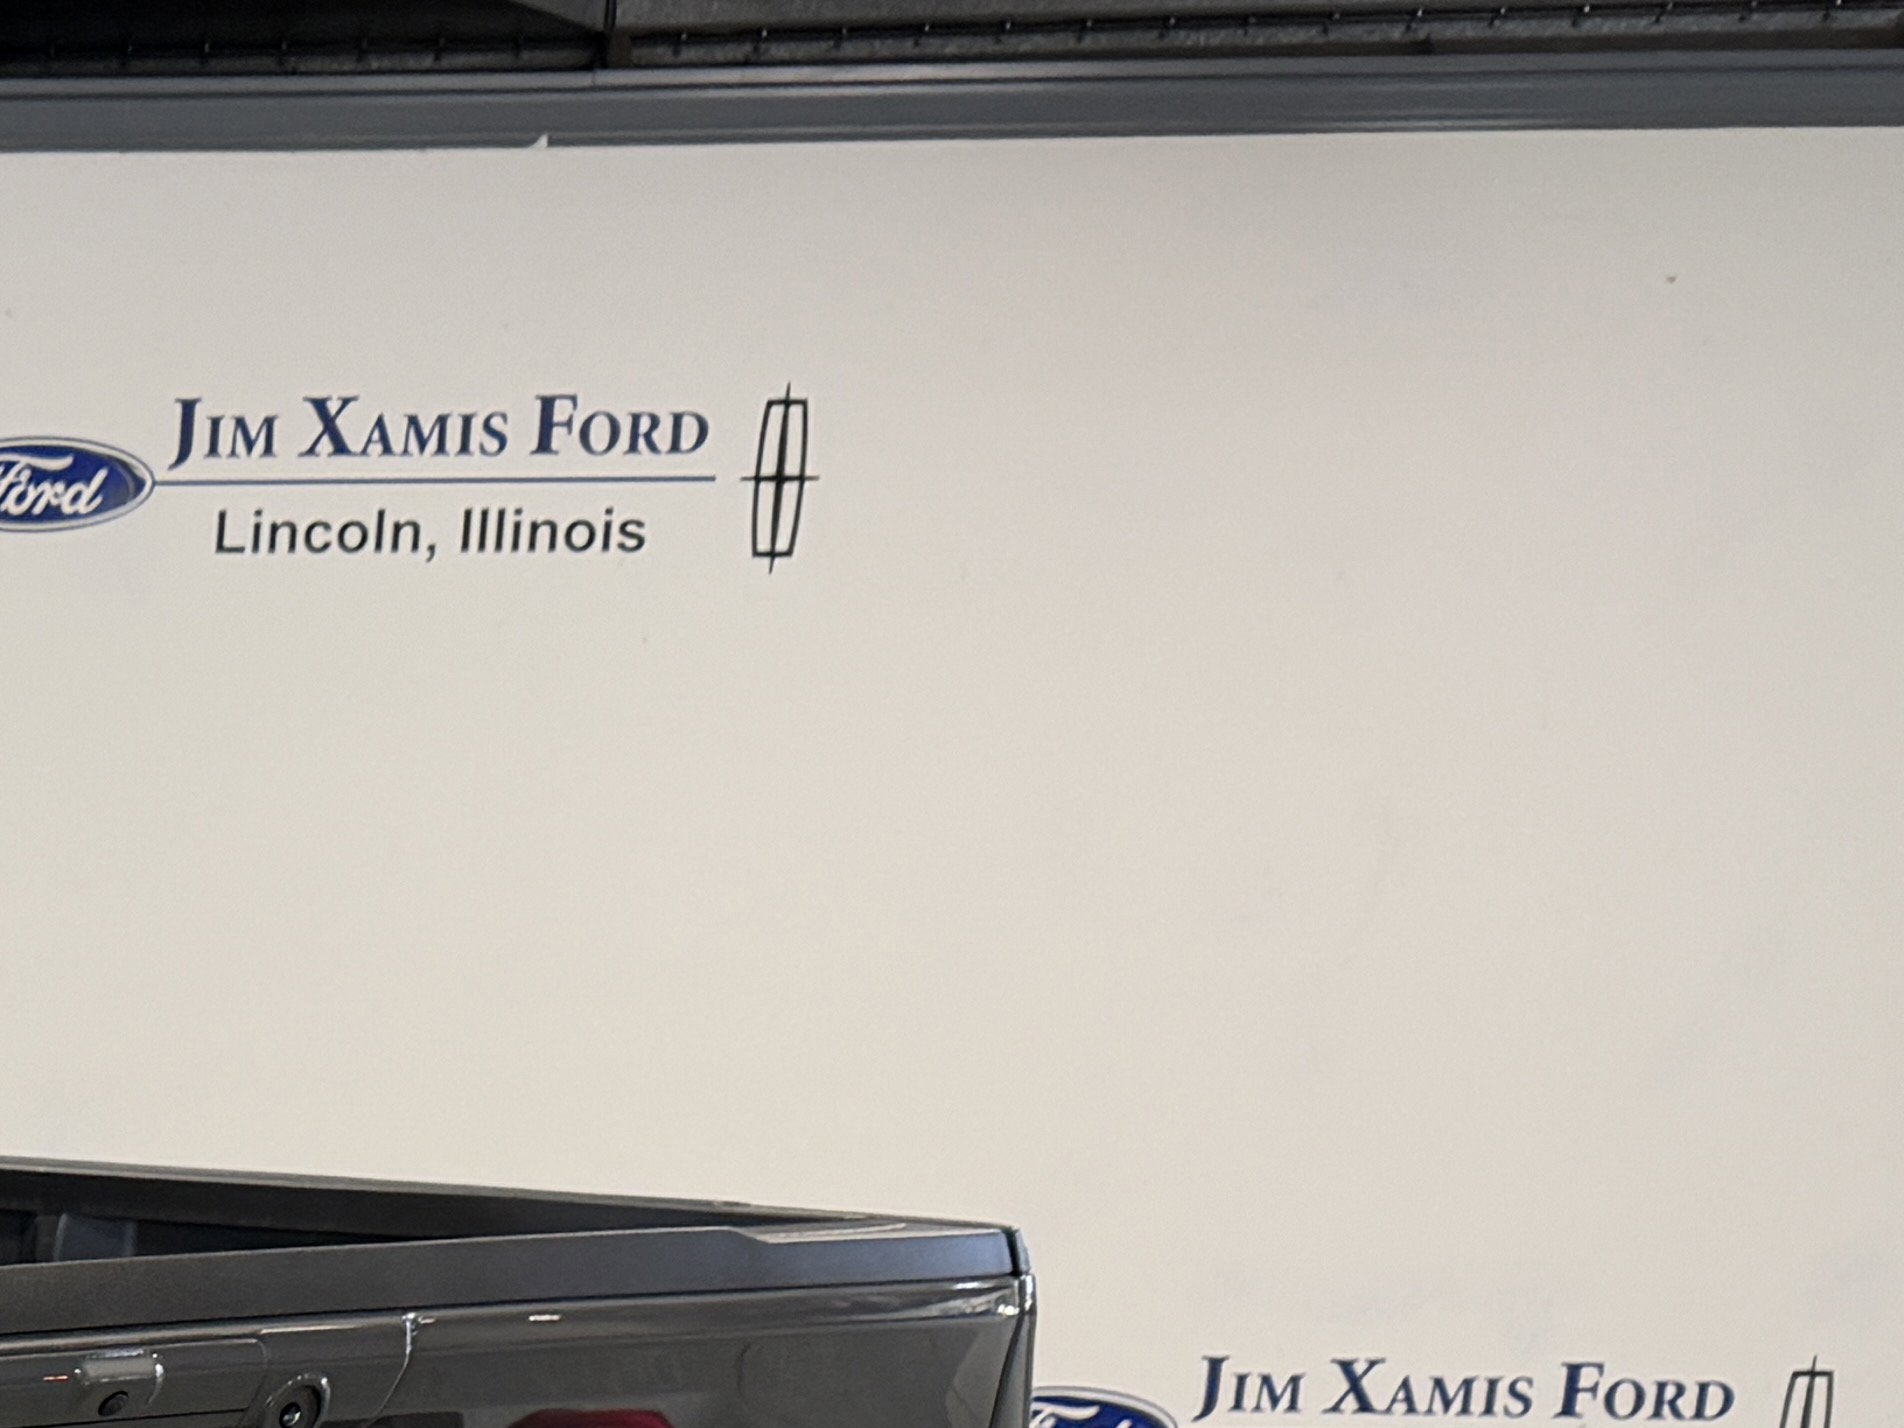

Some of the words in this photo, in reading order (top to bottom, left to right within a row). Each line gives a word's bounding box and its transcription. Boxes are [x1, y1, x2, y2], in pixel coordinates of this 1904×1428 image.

[167, 397, 278, 470] JIM
[298, 395, 509, 458] XAMIS
[530, 394, 710, 456] FORD
[214, 507, 436, 562] Lincoln,
[460, 506, 647, 554] Illinois
[1192, 1355, 1304, 1422] JIM
[1323, 1357, 1534, 1418] XAMIS
[1553, 1361, 1736, 1421] FORD
